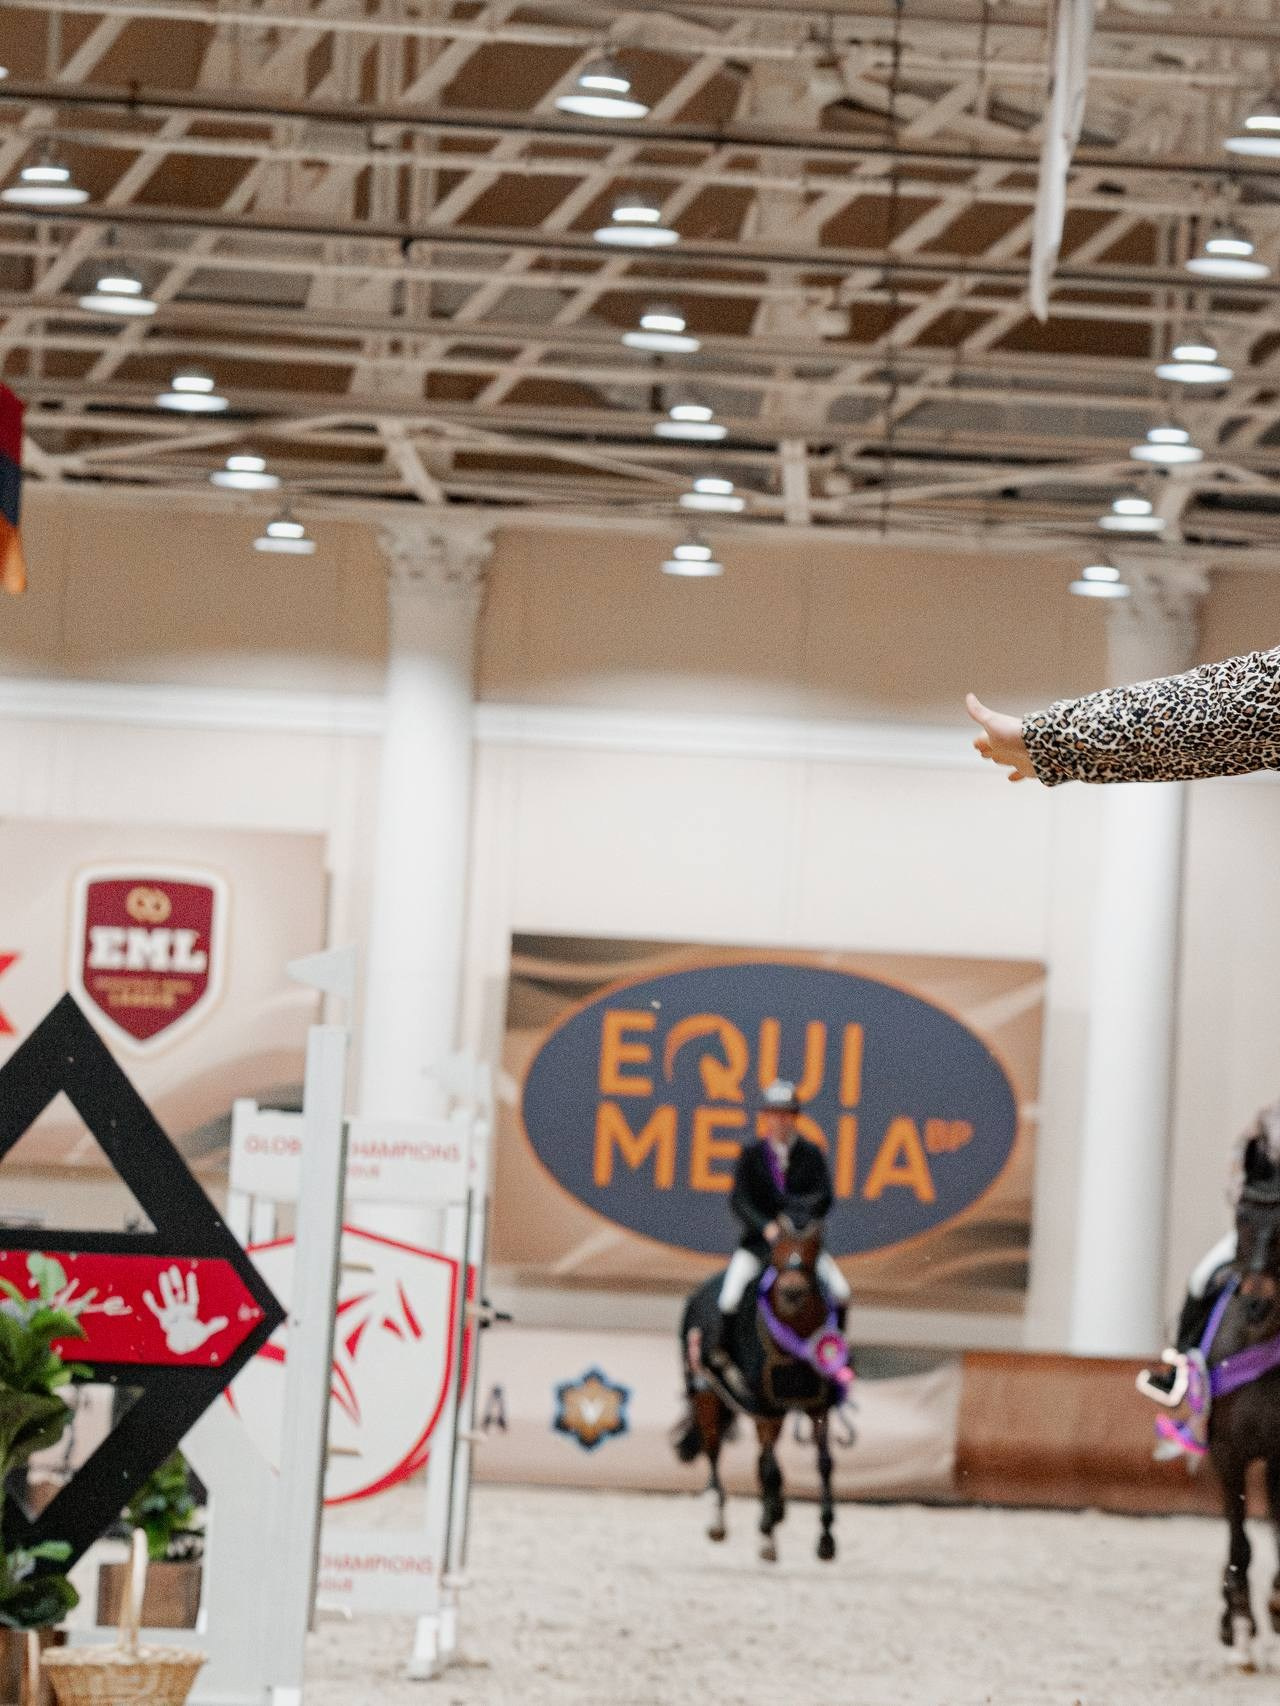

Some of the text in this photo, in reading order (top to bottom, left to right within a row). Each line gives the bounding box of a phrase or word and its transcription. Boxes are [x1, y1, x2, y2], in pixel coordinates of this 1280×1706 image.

[88, 925, 208, 973] EML
[596, 1010, 865, 1108] EQUI
[244, 1136, 461, 1162] GLOB HAMPIONS
